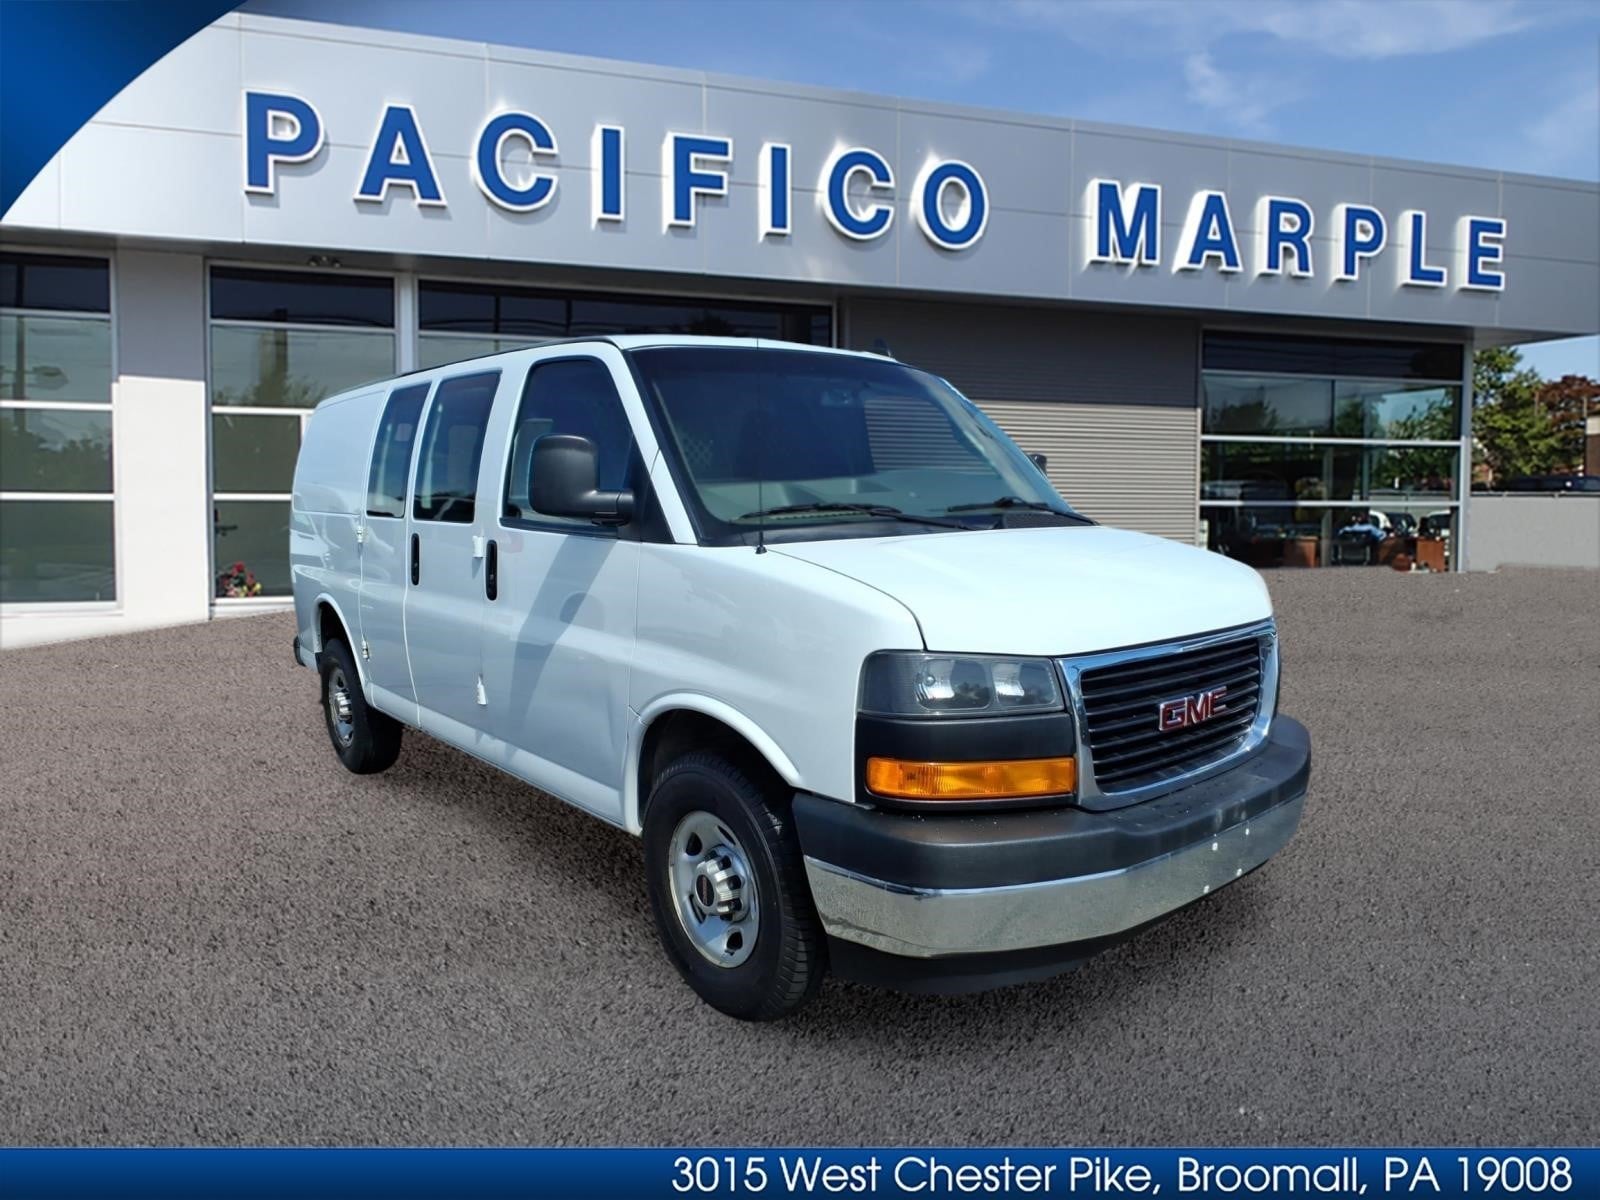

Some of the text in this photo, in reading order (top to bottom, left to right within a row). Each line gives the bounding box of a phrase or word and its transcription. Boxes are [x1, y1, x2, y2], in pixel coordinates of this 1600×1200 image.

[243, 88, 1507, 292] PACIFICO MARPLE
[1158, 685, 1228, 732] GMC
